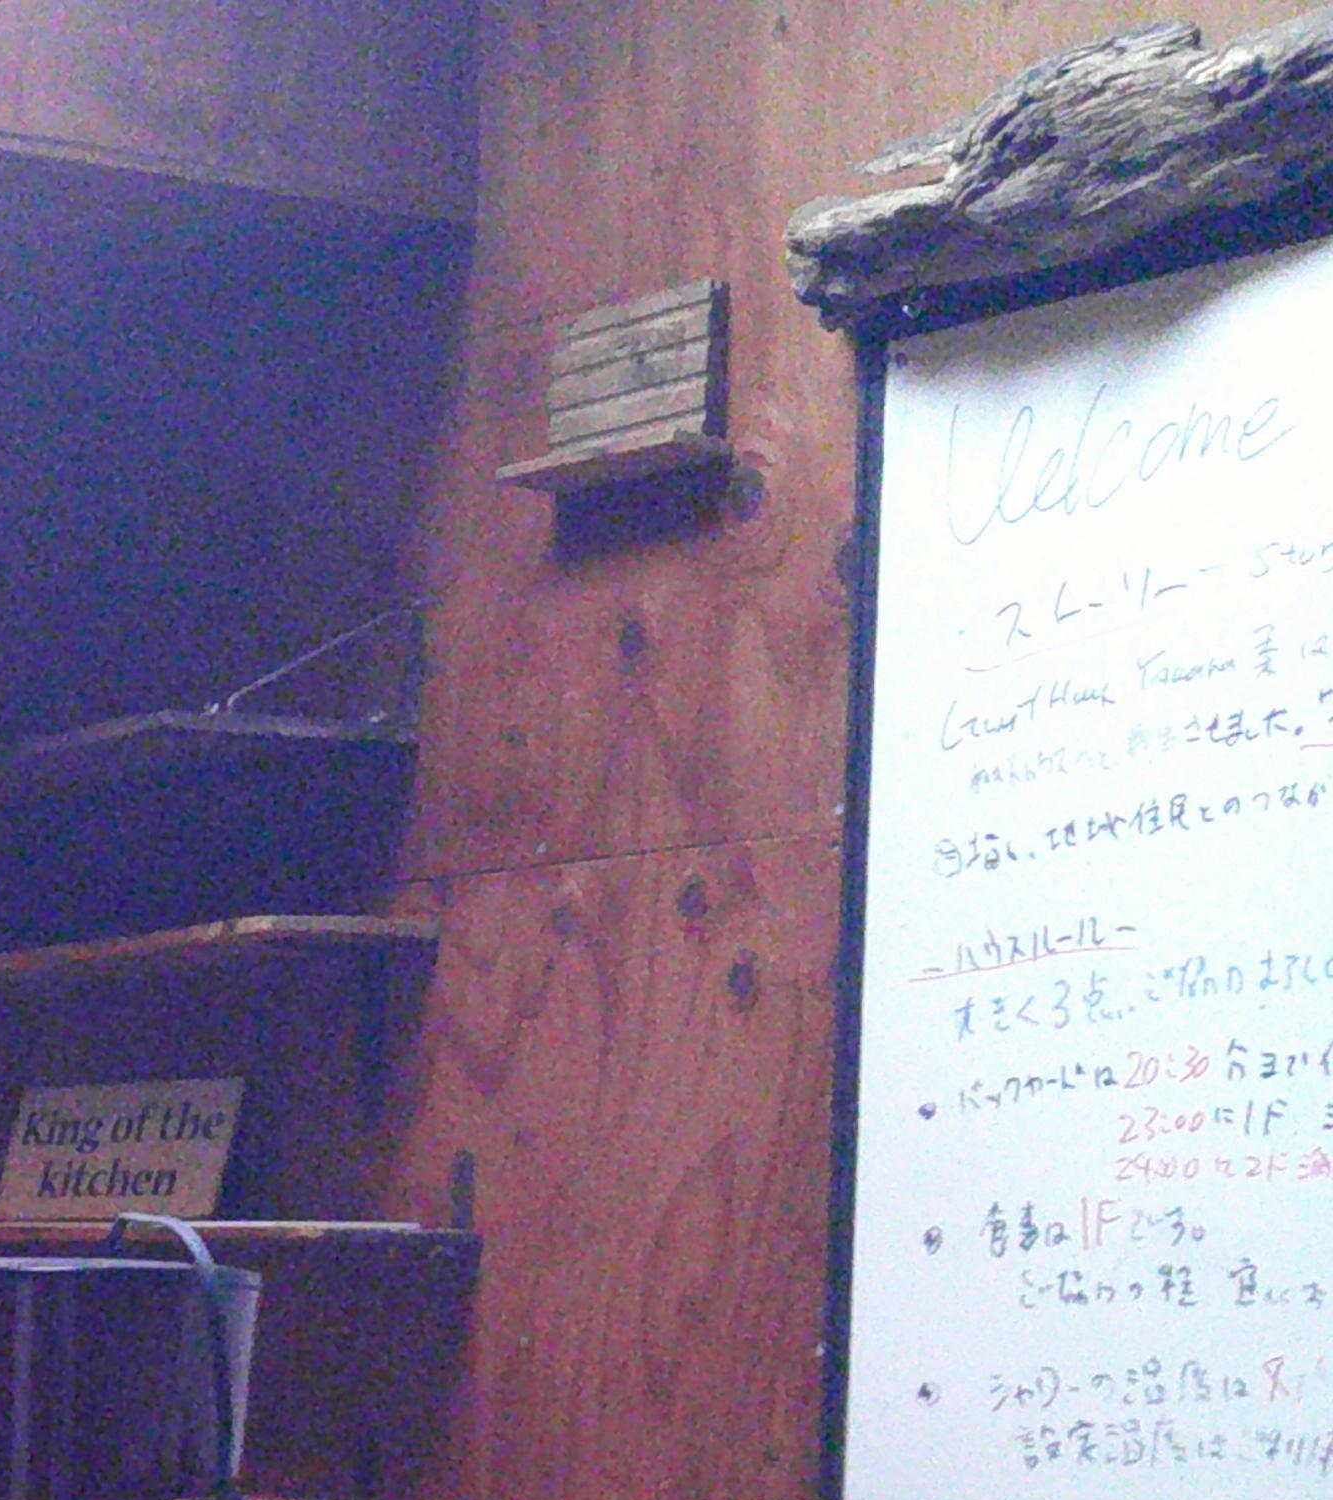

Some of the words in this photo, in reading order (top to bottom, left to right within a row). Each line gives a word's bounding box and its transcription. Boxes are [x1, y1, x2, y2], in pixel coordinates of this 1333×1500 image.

[21, 1109, 104, 1153] King
[110, 1106, 151, 1145] of
[159, 1101, 226, 1142] the
[36, 1157, 177, 1199] kitchen
